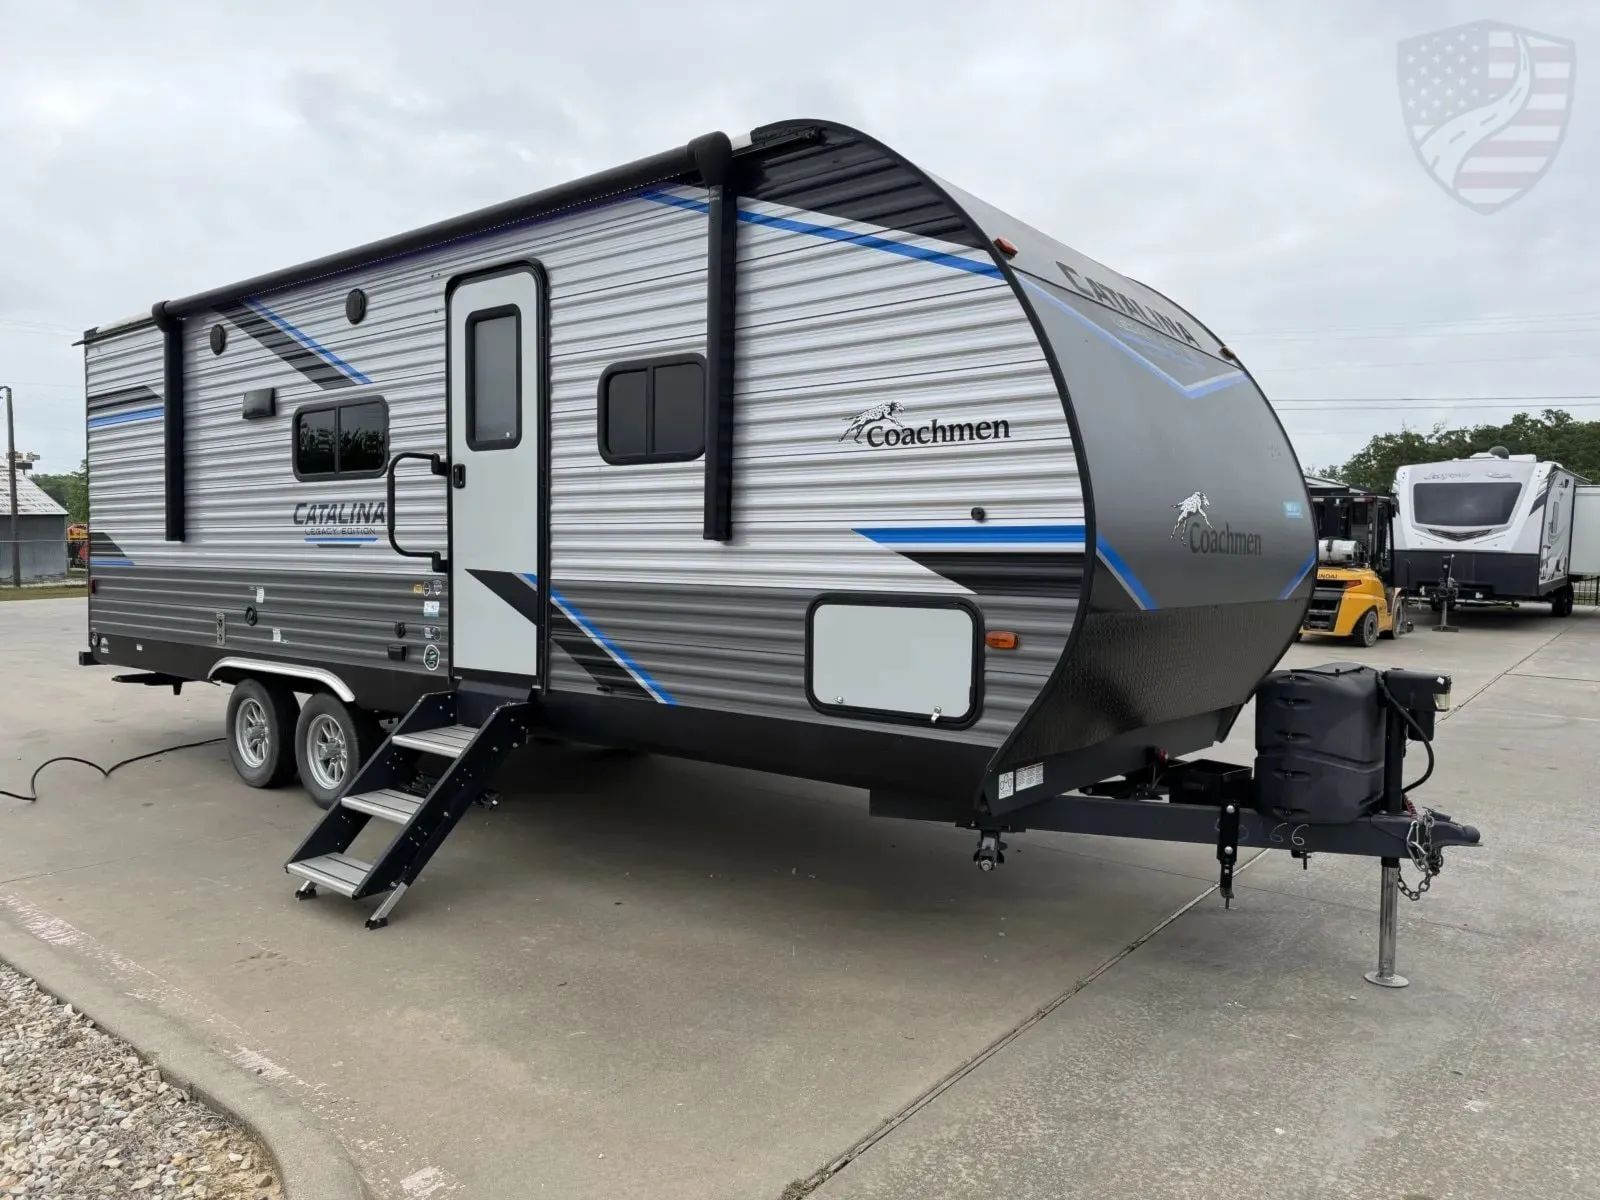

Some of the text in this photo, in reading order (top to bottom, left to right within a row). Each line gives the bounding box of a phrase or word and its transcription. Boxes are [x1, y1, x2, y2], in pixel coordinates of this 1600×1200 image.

[1055, 261, 1202, 349] CATALINA
[866, 418, 1010, 447] Coachmen
[293, 502, 385, 525] CATALINA
[304, 527, 376, 536] LEGACY EDITION
[1189, 521, 1262, 556] Coachmen
